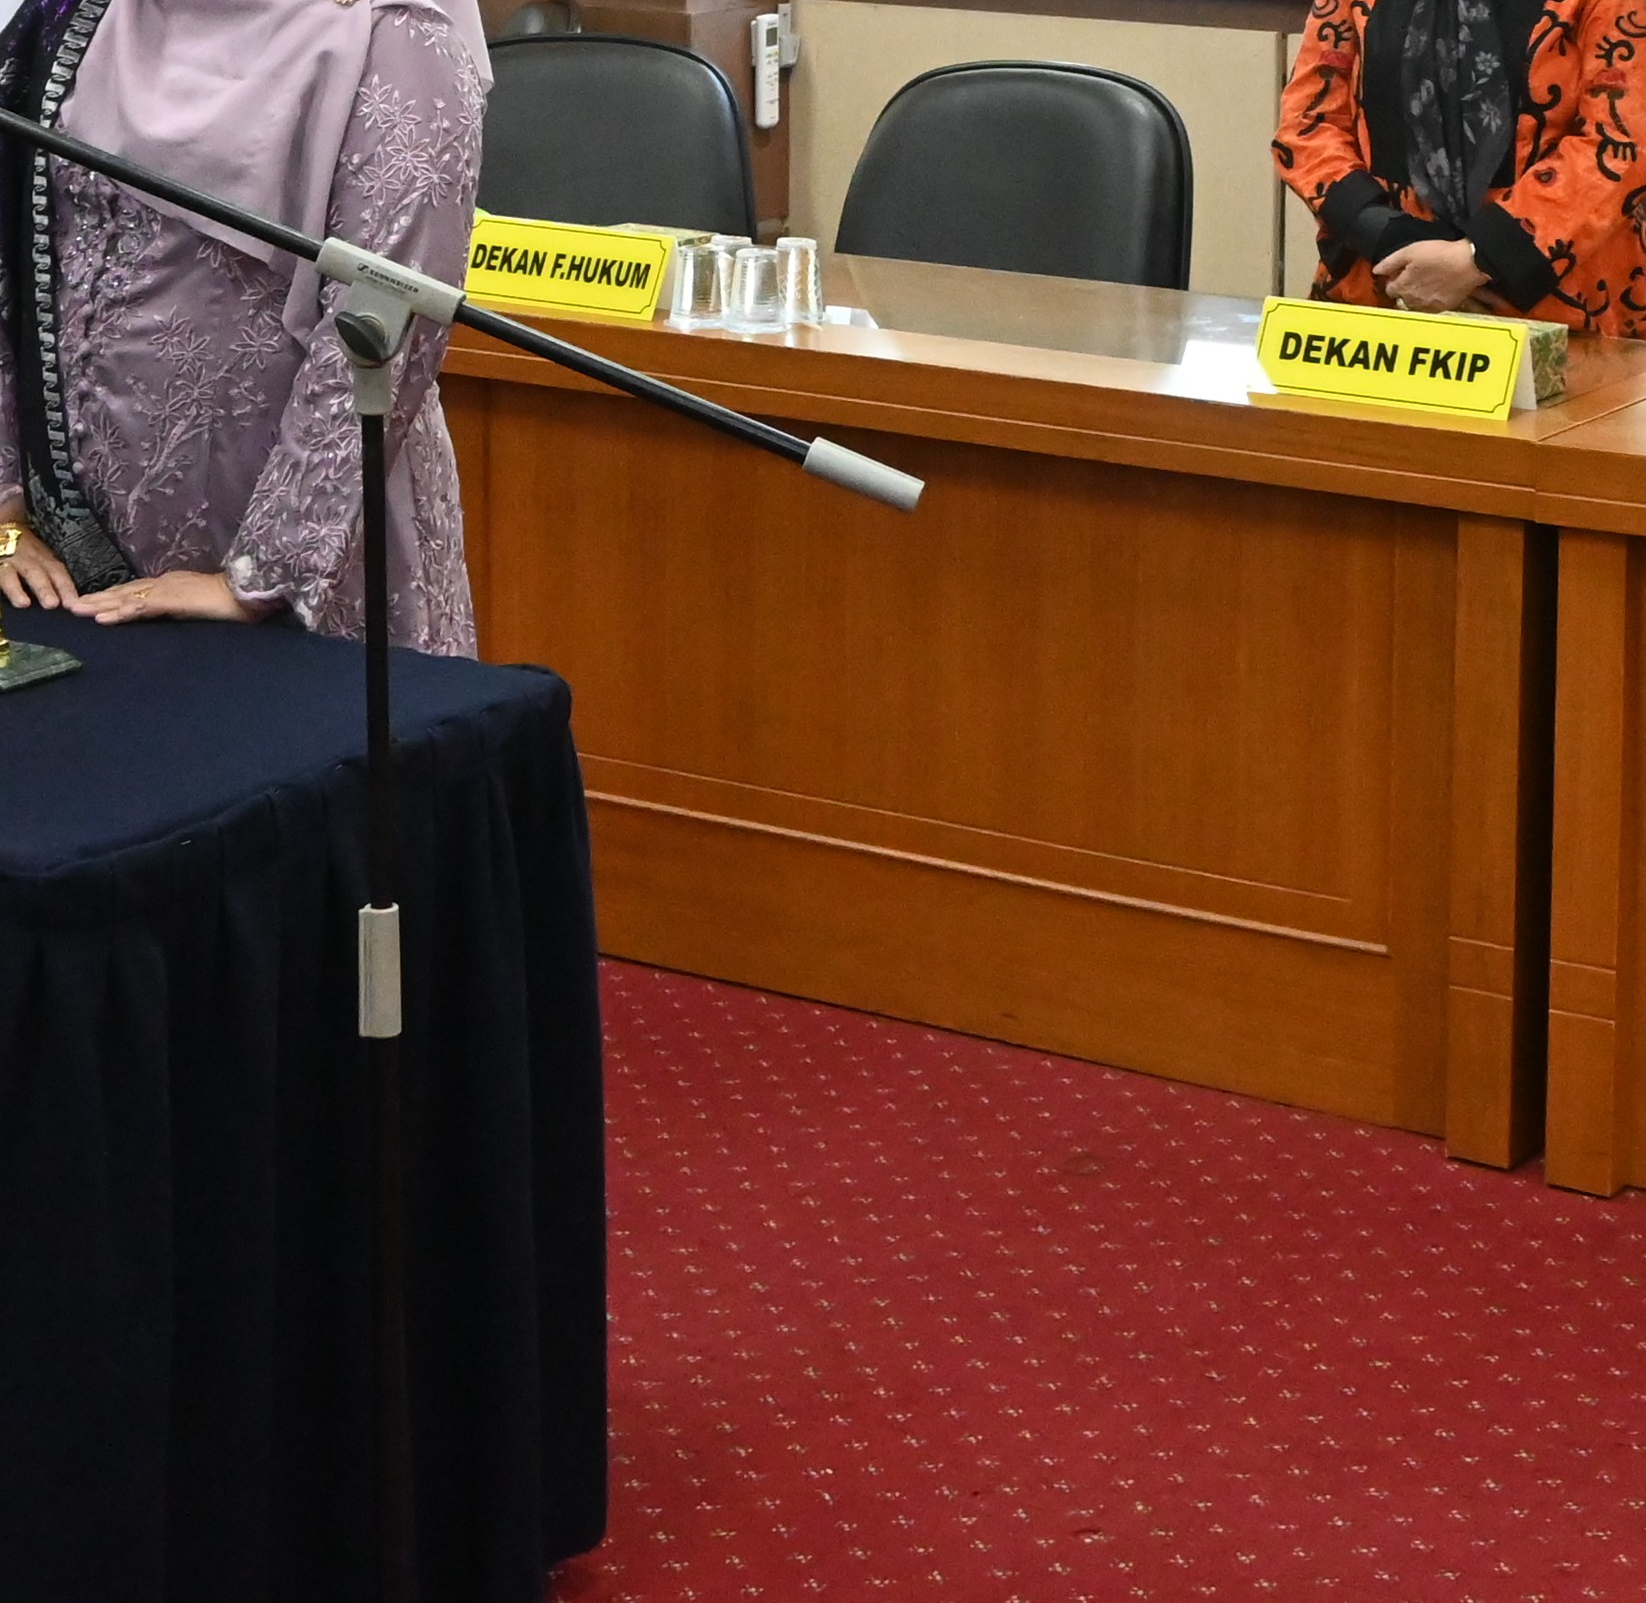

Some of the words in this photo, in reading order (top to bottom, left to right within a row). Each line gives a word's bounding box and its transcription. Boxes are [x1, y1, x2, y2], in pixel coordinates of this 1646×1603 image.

[470, 242, 548, 277] DEKAN
[549, 252, 652, 290] F.HUKUM
[1278, 330, 1399, 374] DEKAN
[1408, 346, 1491, 383] FKIP
